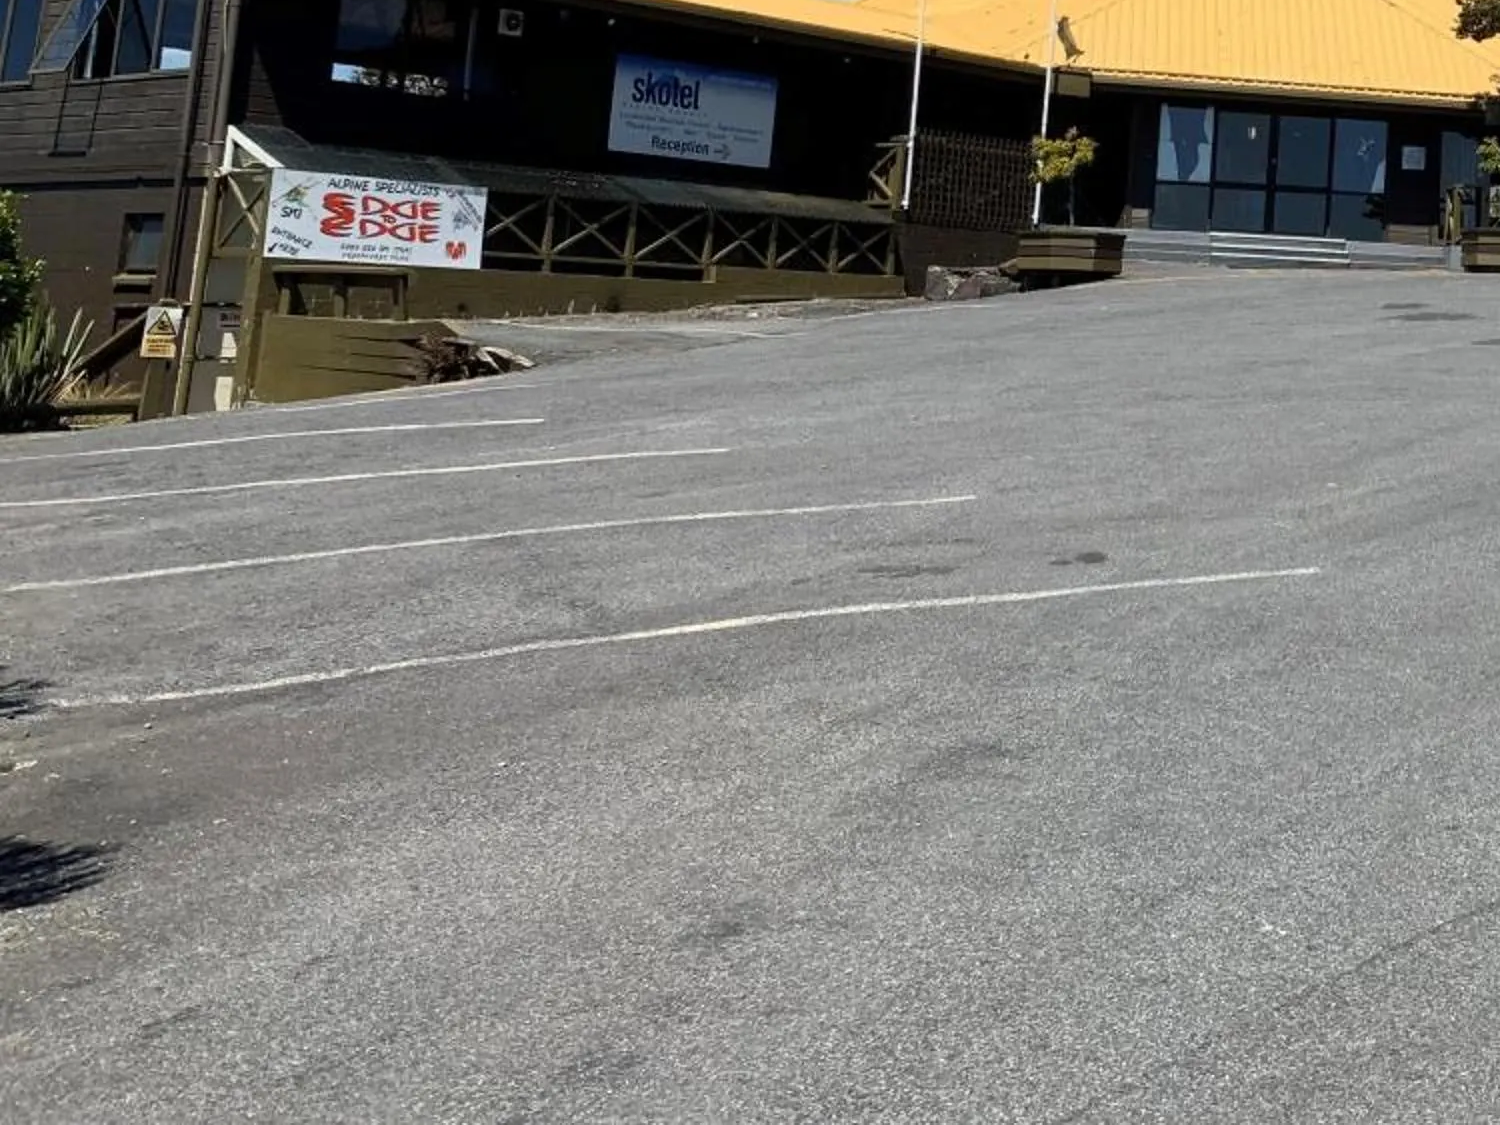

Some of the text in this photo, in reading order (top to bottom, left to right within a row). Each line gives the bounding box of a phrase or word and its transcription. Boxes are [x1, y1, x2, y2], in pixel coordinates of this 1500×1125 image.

[651, 136, 709, 156] Reception
[328, 178, 370, 191] ALPINE
[375, 181, 441, 196] SPECIALISTS
[321, 192, 442, 221] EDGE
[320, 216, 440, 243] EDGE
[382, 215, 397, 224] TO
